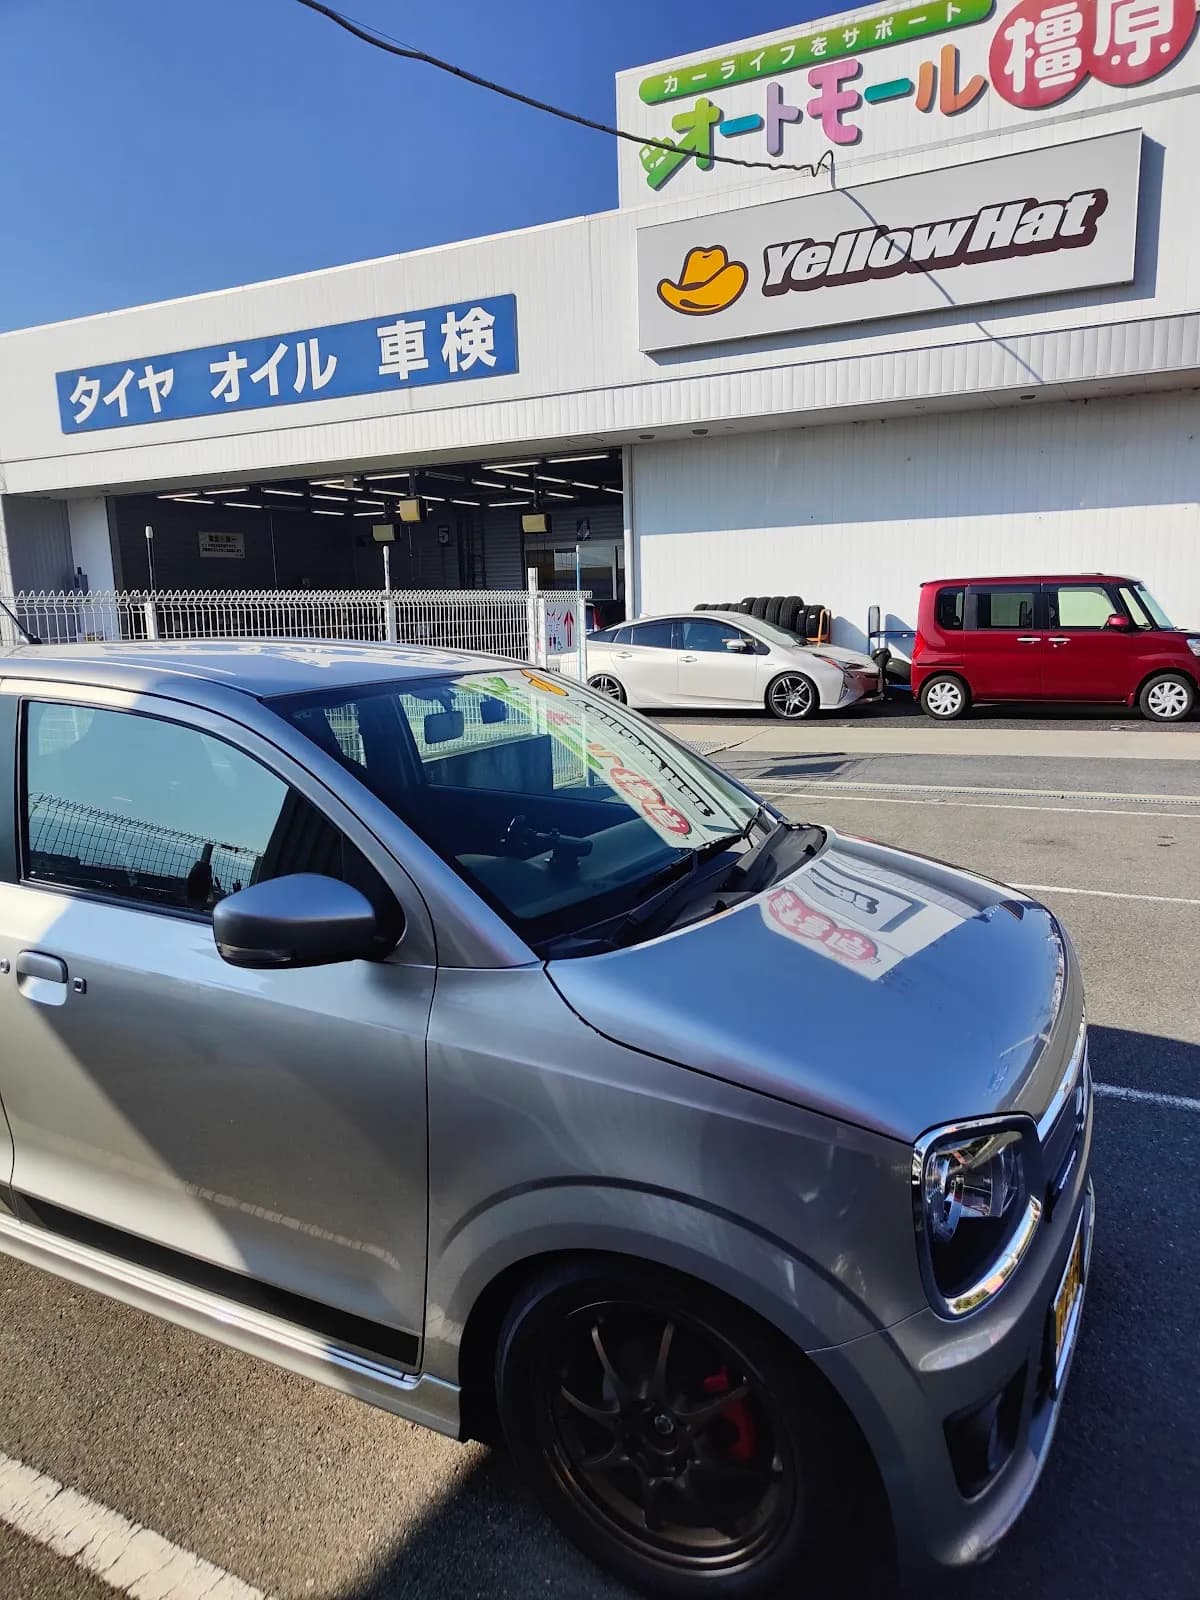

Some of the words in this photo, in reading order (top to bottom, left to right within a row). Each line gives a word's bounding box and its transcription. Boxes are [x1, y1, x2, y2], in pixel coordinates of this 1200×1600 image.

[663, 3, 962, 94] カーライフをサポート
[69, 365, 174, 424] タイヤ
[209, 337, 338, 403] オイル
[377, 307, 497, 380] 車検
[439, 527, 450, 544] 5
